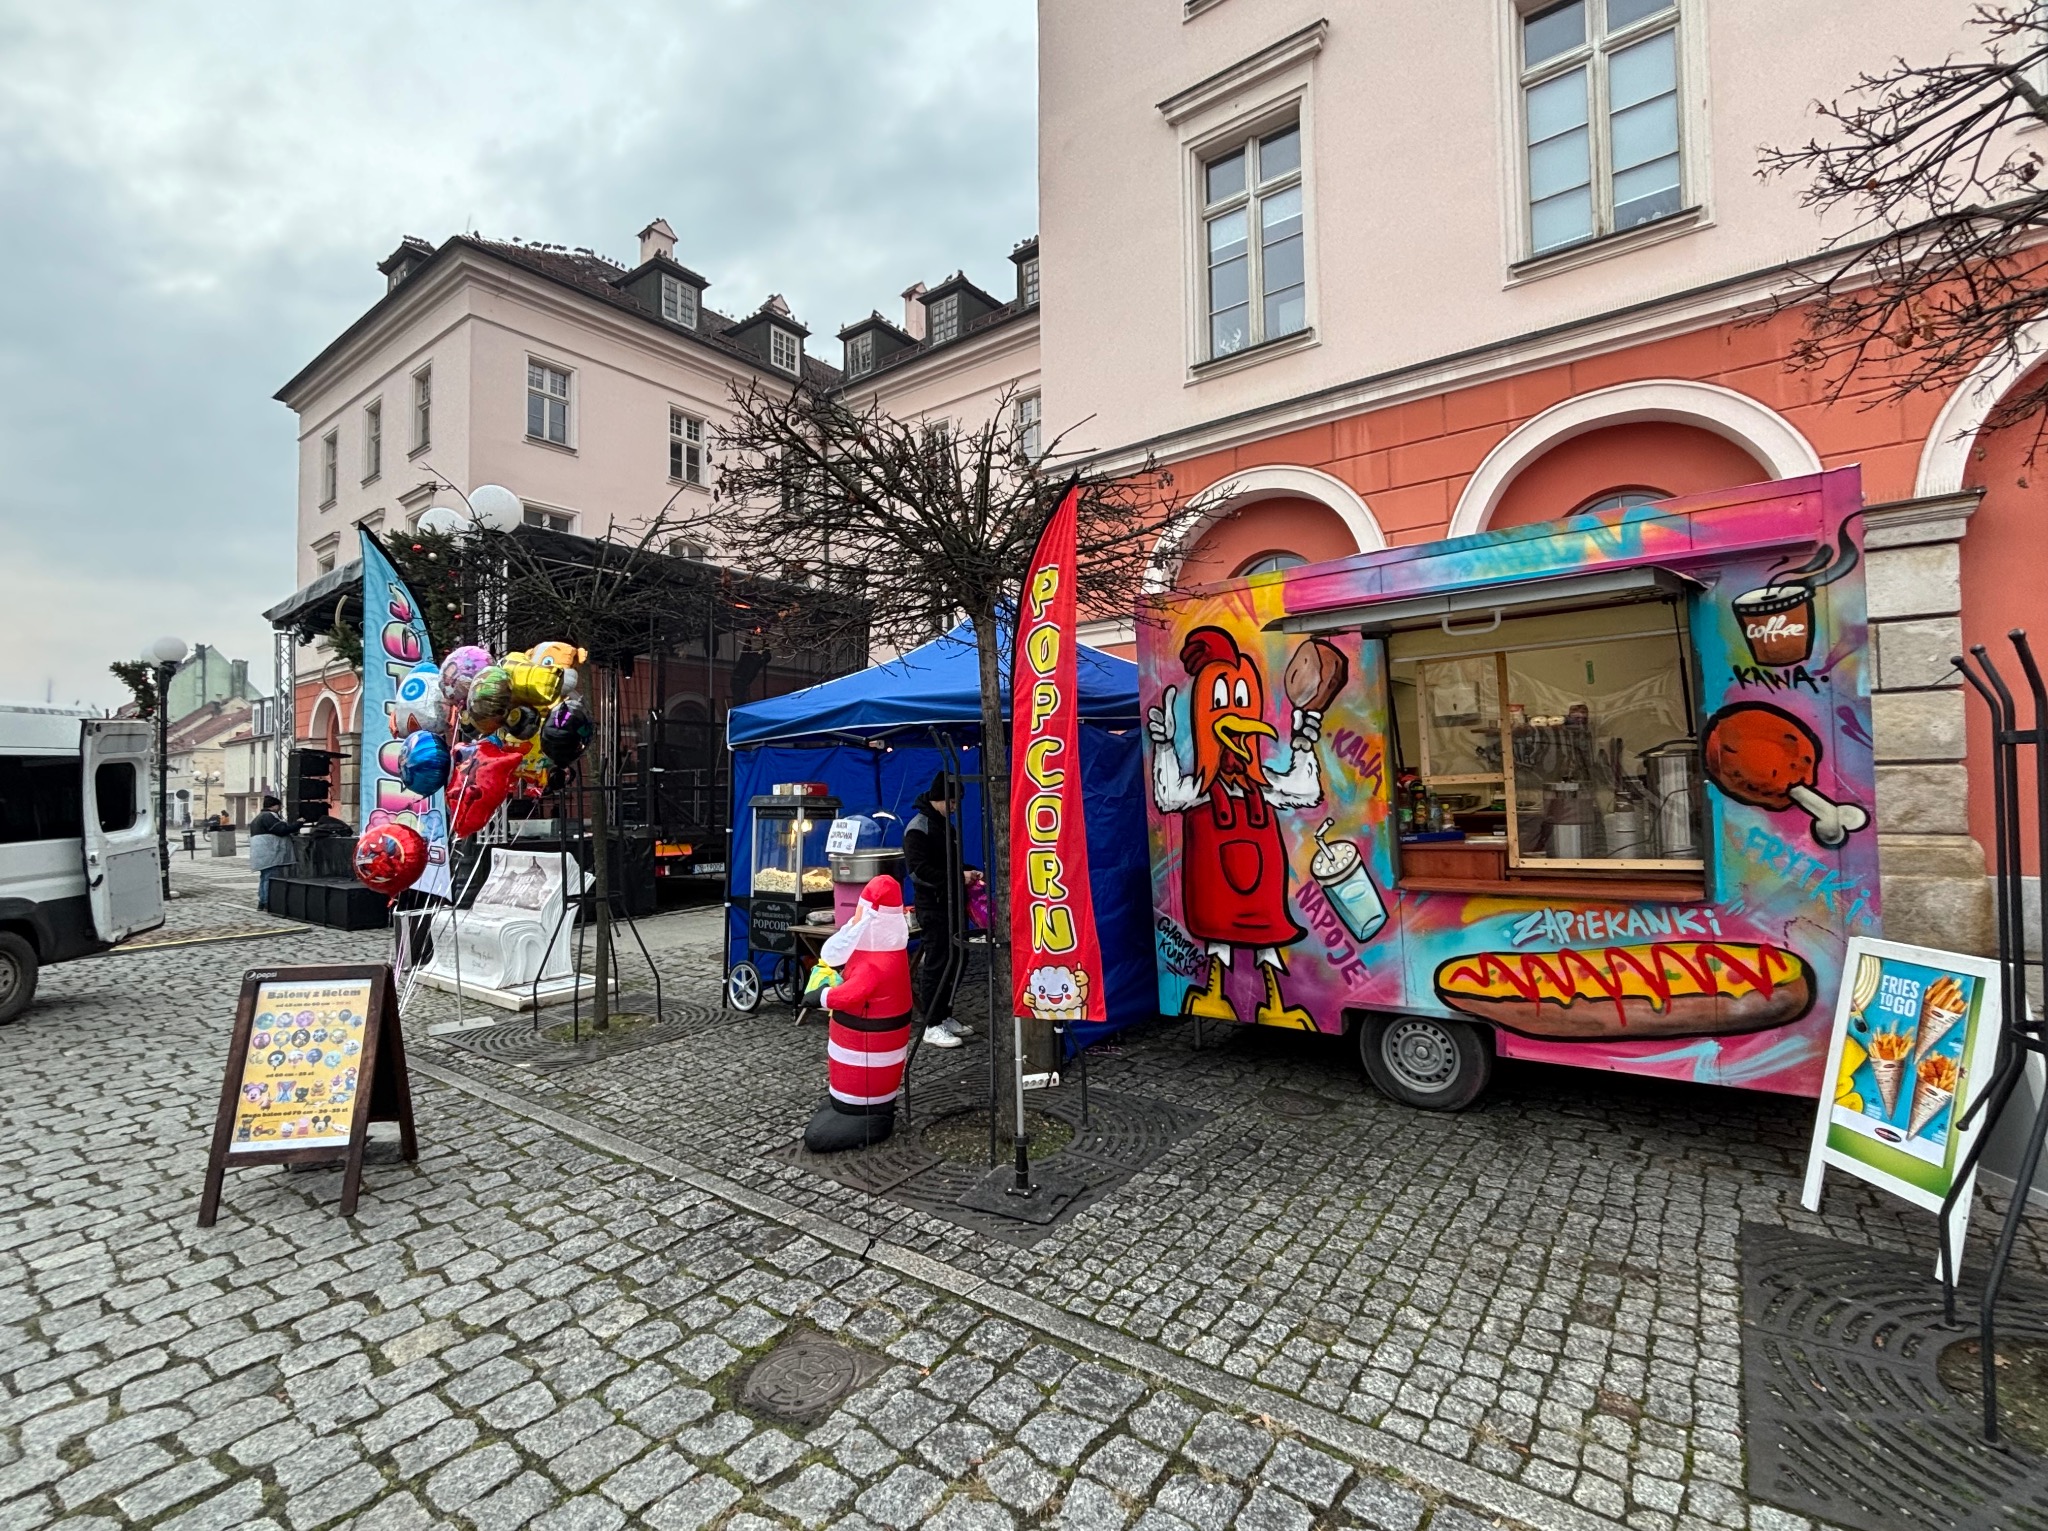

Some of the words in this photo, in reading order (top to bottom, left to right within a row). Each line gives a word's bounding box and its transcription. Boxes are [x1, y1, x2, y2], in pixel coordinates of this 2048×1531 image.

[1747, 615, 1804, 643] coffee
[1025, 565, 1076, 952] POPCORN
[1295, 880, 1367, 985] NAPOJE
[1158, 938, 1200, 980] KURKA
[256, 971, 277, 979] pepsi
[1881, 974, 1920, 999] FRIES
[267, 991, 311, 999] Balony
[322, 989, 361, 997] Helem
[1880, 992, 1893, 1006] TO
[1893, 996, 1916, 1017] GO
